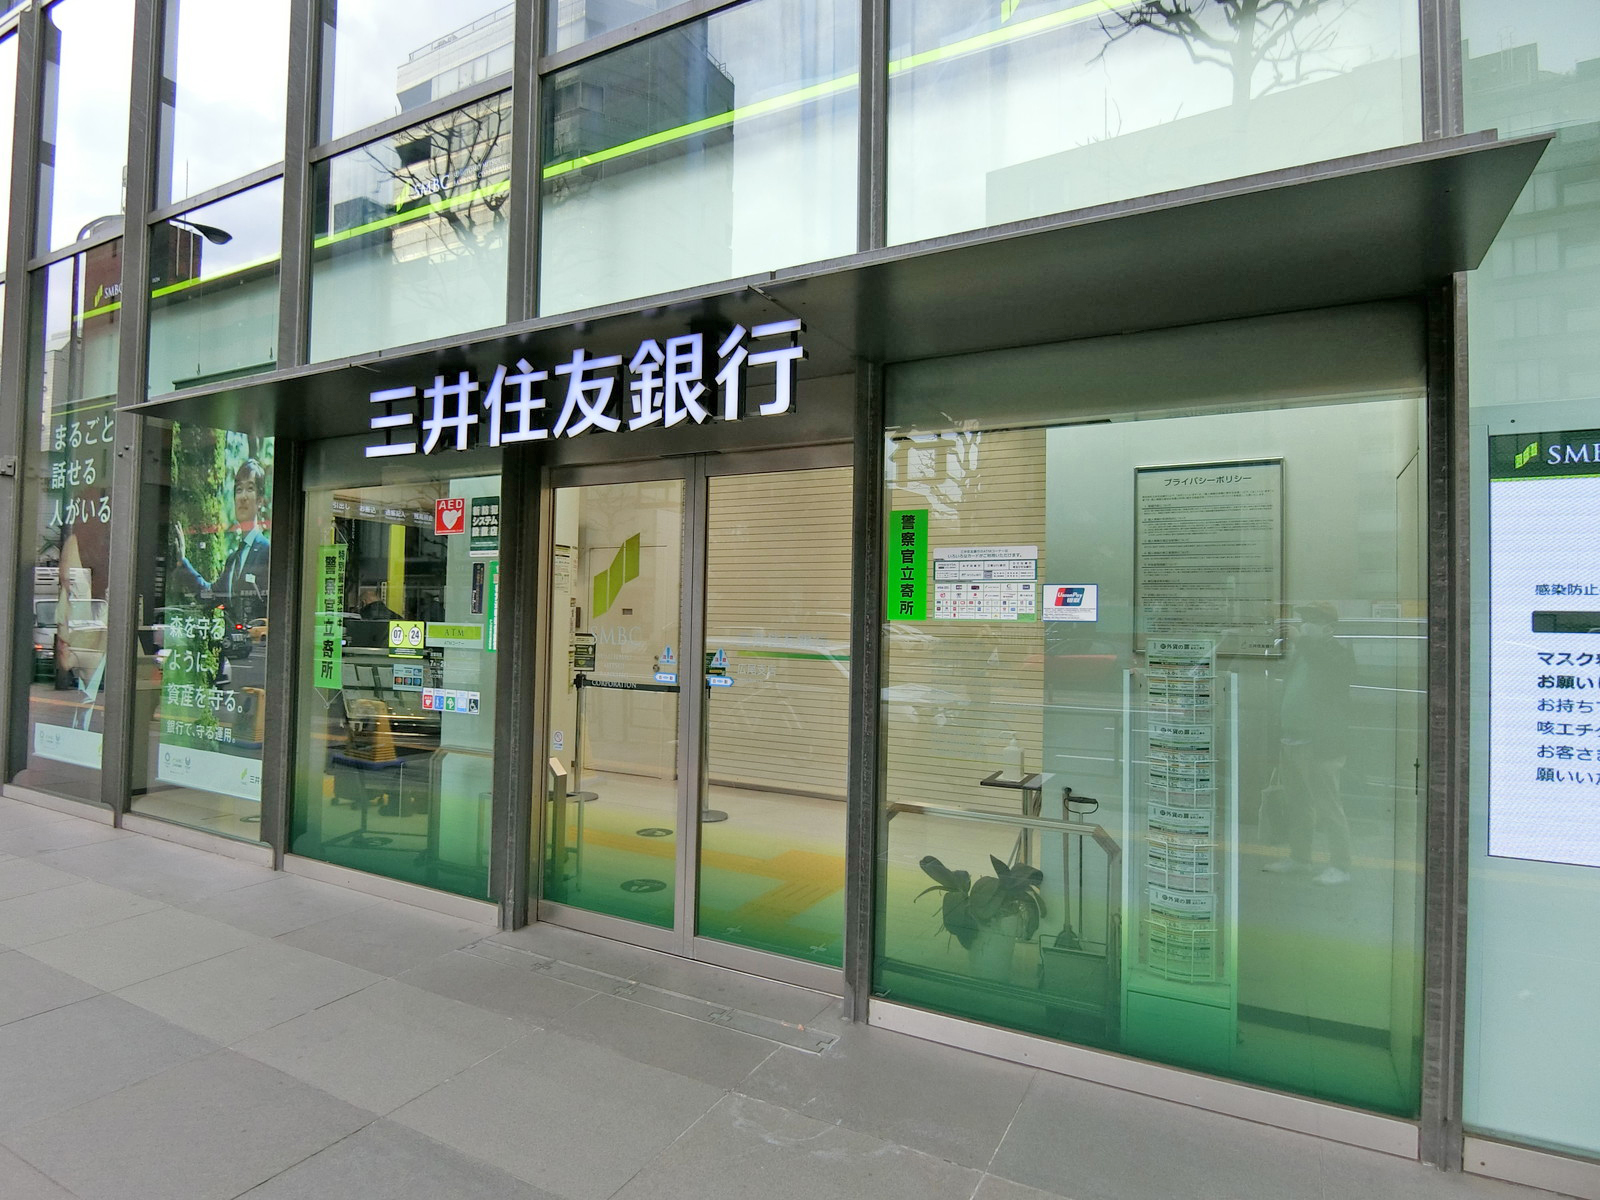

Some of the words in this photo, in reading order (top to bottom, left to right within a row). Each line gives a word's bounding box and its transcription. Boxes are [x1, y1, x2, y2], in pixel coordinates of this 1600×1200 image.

[365, 318, 804, 458] 三井住友銀行
[54, 415, 114, 451] まるごと
[51, 458, 96, 490] 話せる
[1164, 475, 1252, 487] プライバシーポリシー
[49, 496, 111, 526] 人がいる
[438, 499, 463, 510] AED
[472, 515, 498, 527] システム
[900, 514, 916, 616] 警察官立寄所
[320, 555, 337, 680] 警察官立寄所
[169, 615, 226, 640] 森を守る
[393, 629, 402, 639] 07
[410, 630, 420, 640] 24
[444, 628, 465, 637] ATM
[590, 625, 643, 646] SMBC
[1537, 652, 1600, 667] マスク
[591, 679, 637, 689] CORPORATION
[1537, 674, 1600, 690] お願い
[166, 683, 243, 714] 資産を守る。
[1537, 697, 1600, 714] お持ち
[166, 720, 236, 744] 銀行で、守る運用。
[1537, 744, 1600, 762] お客さ
